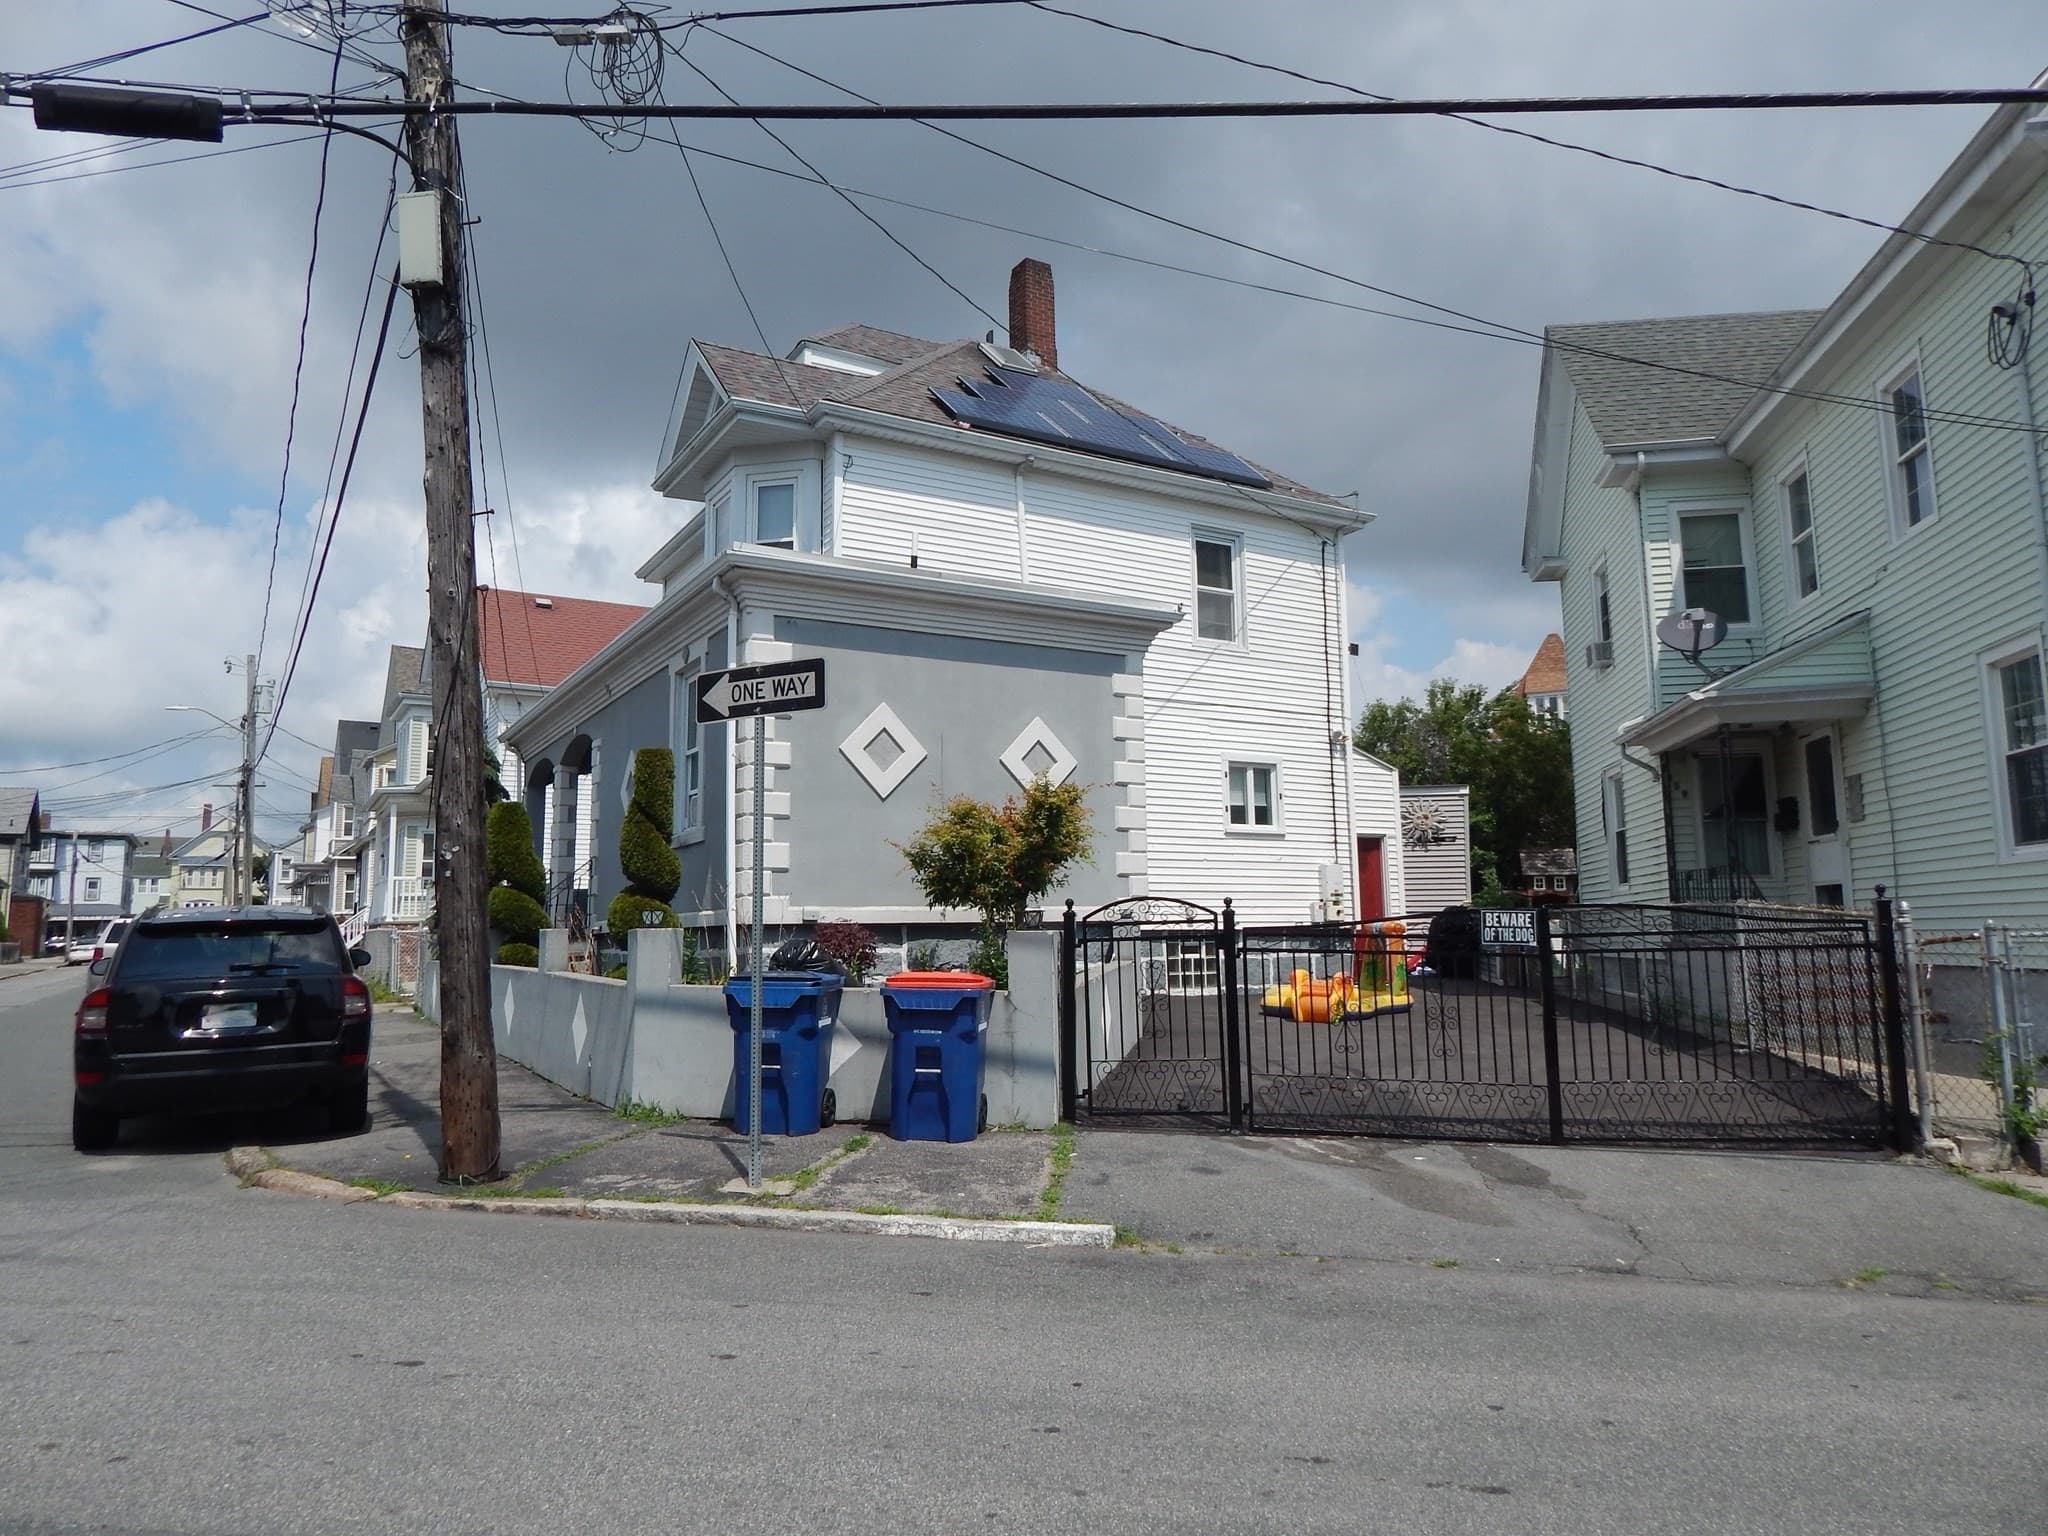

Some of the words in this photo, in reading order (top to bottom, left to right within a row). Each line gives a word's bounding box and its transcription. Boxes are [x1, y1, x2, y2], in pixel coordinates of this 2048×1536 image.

[731, 681, 766, 703] ONE
[772, 675, 810, 697] WAY
[1485, 913, 1532, 927] BEWARE
[1484, 927, 1496, 941] OF
[1497, 928, 1514, 941] THE
[1515, 928, 1534, 942] DOG
